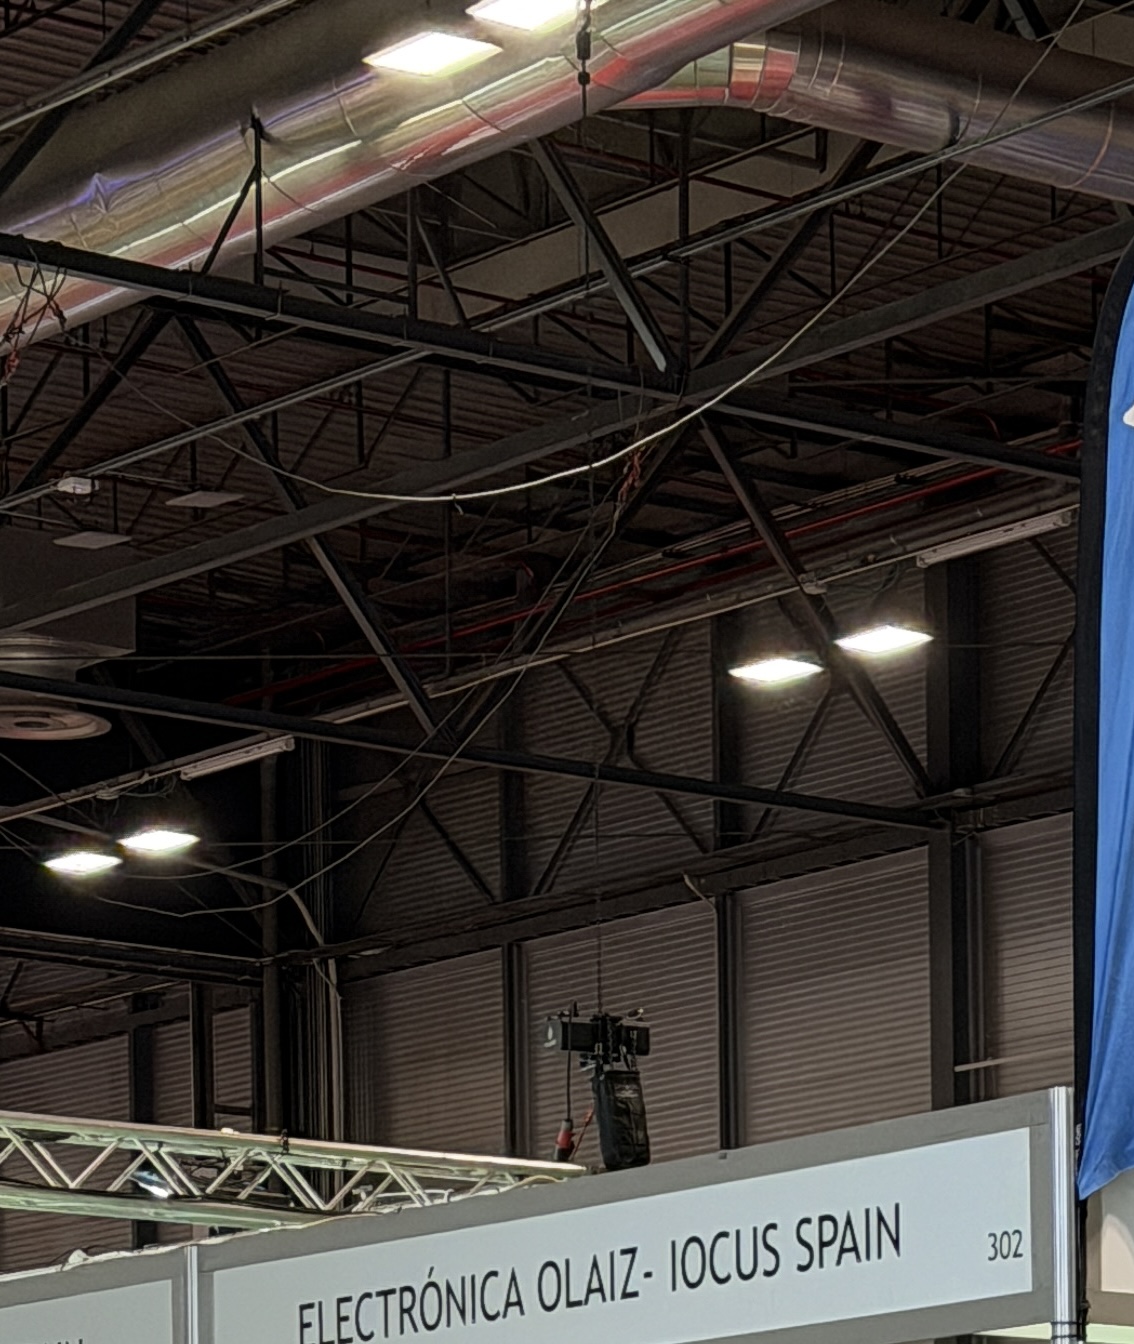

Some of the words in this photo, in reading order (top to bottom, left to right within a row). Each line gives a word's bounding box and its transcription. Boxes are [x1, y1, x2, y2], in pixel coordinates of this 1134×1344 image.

[537, 1246, 653, 1315] OLAIZ-
[670, 1222, 780, 1292] IOCUS
[796, 1202, 902, 1272] SPAIN
[987, 1229, 1024, 1261] 302
